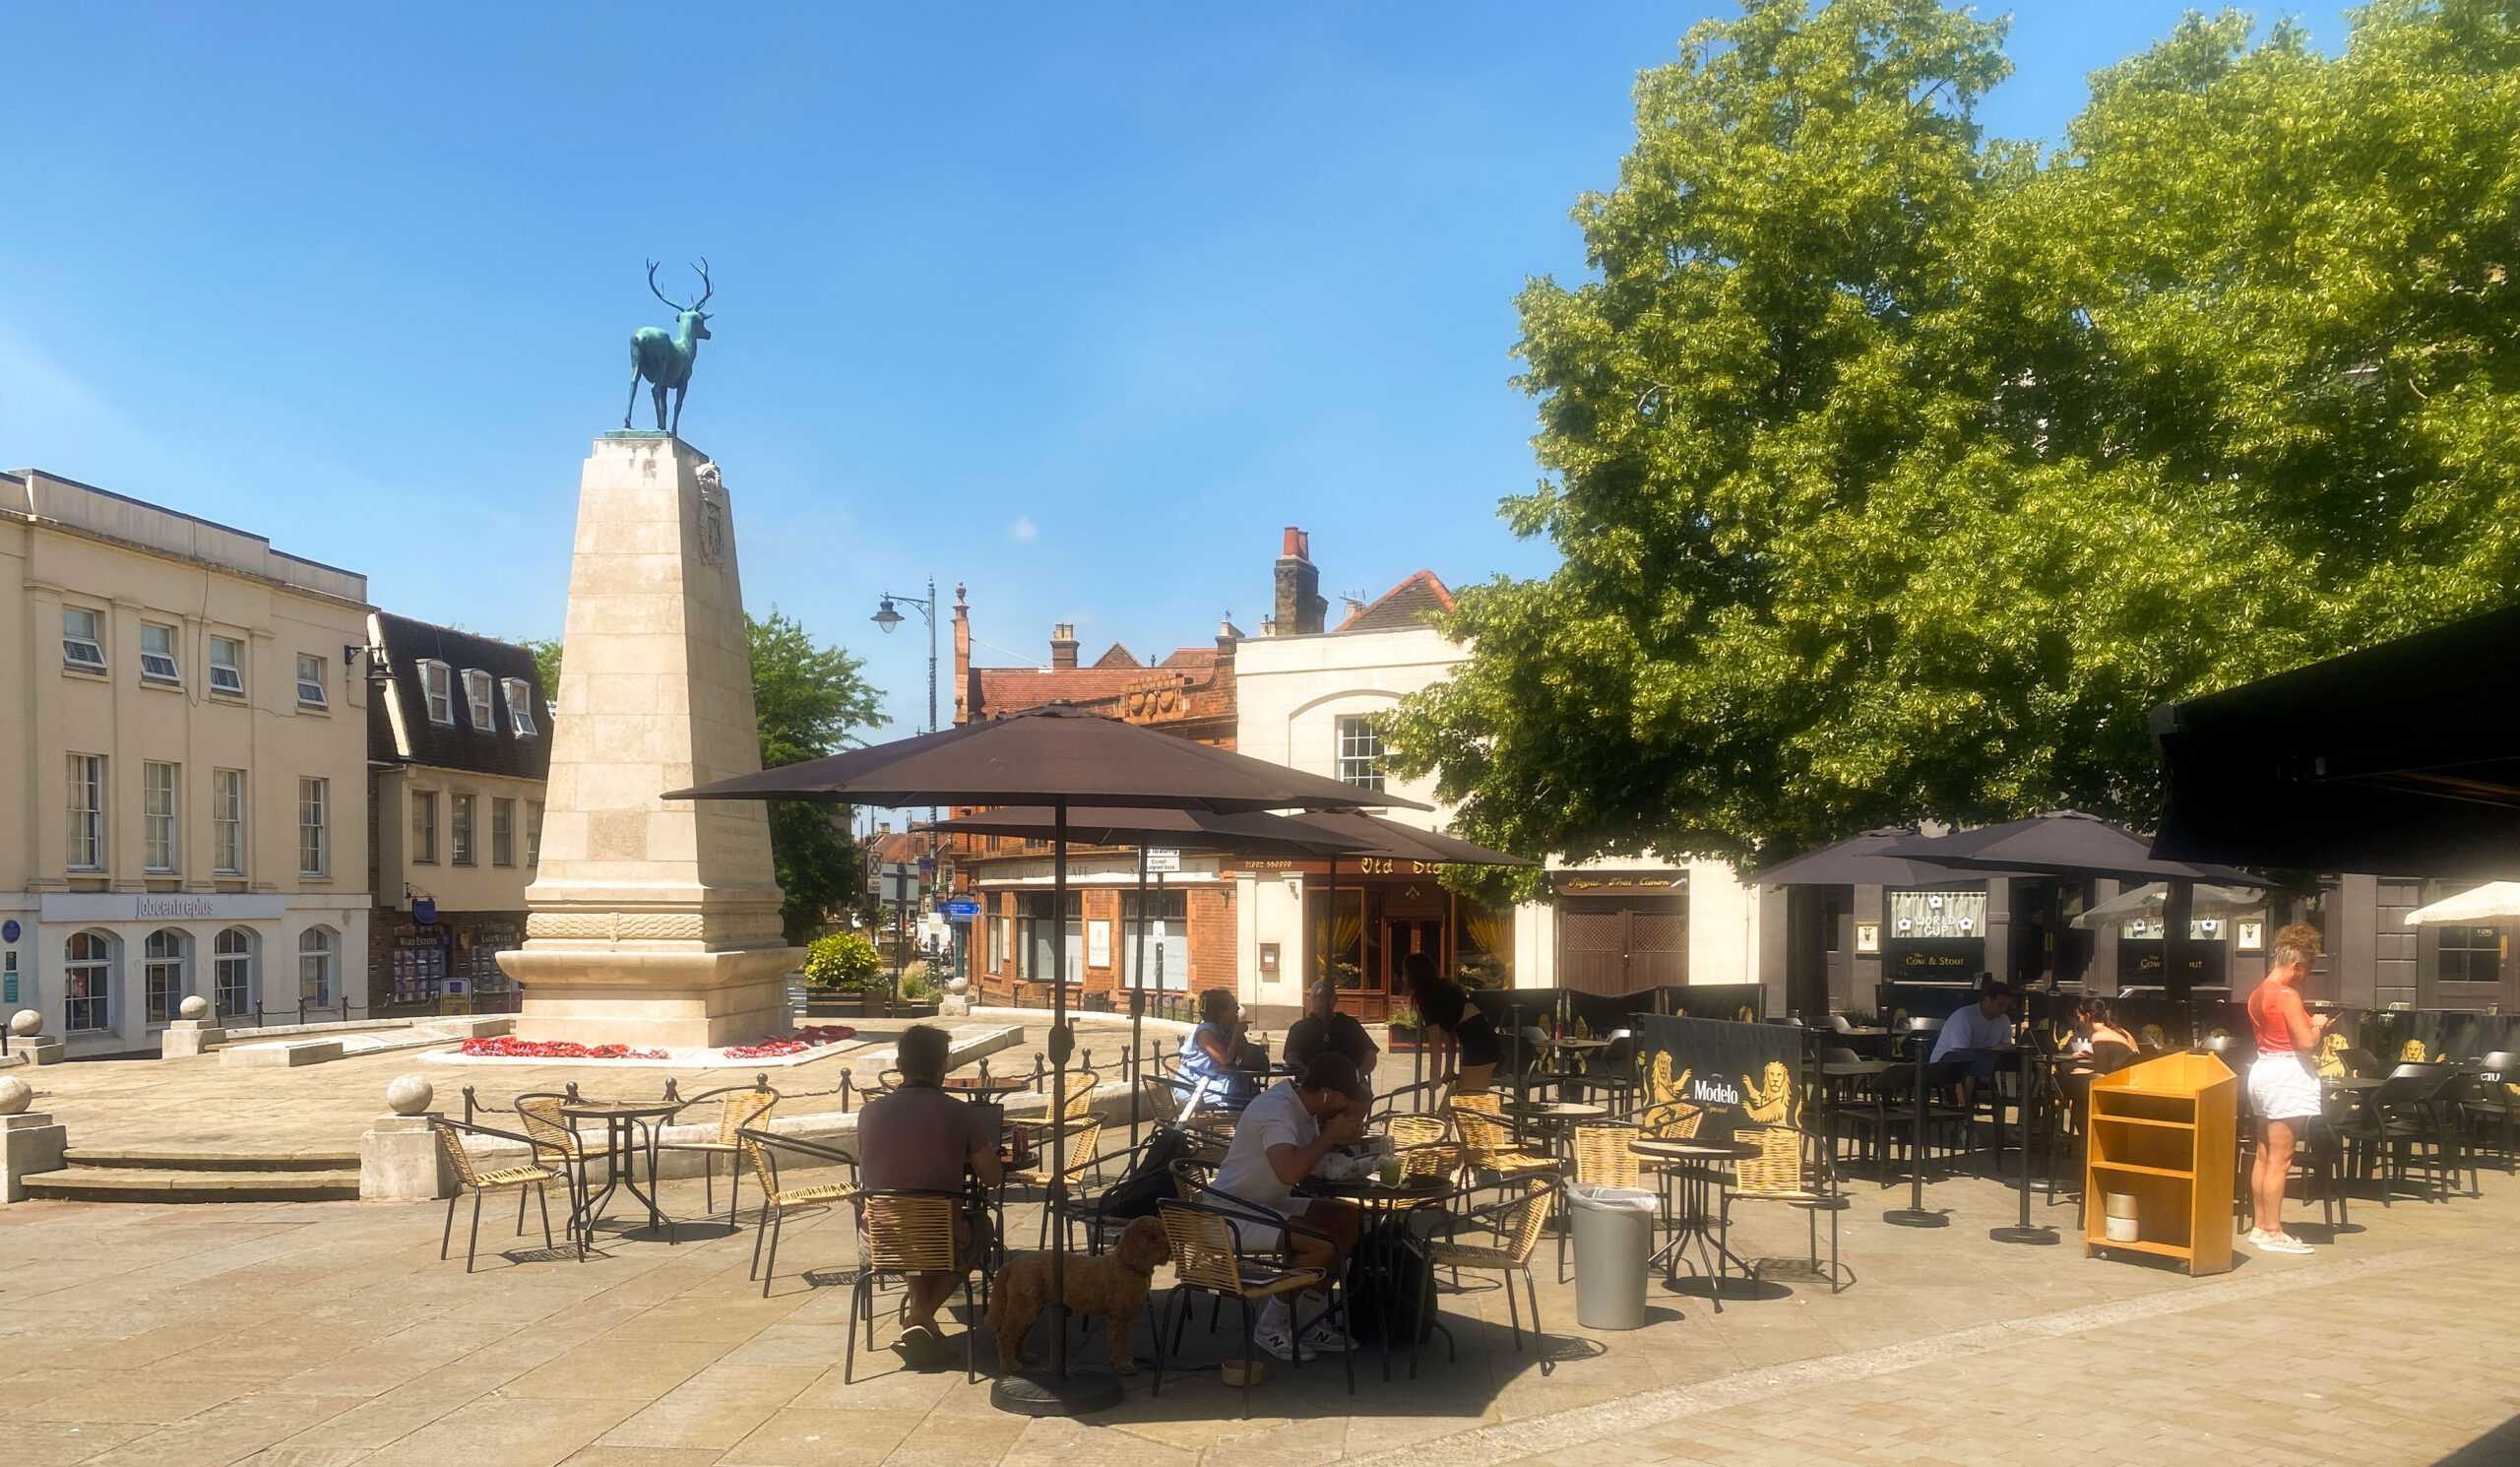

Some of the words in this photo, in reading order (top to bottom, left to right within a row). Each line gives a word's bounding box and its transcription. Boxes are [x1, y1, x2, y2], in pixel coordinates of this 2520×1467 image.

[1360, 857, 1394, 874] Old
[1609, 876, 1632, 886] Thai
[135, 896, 214, 921] jobcentreplus
[1914, 915, 1956, 926] WORLD
[1923, 925, 1950, 936] CUP
[1906, 956, 1926, 966] Cow
[1928, 957, 1937, 966] &
[1938, 957, 1965, 966] Stout
[2140, 959, 2161, 969] Cow
[1694, 1079, 1739, 1105] Modelo
